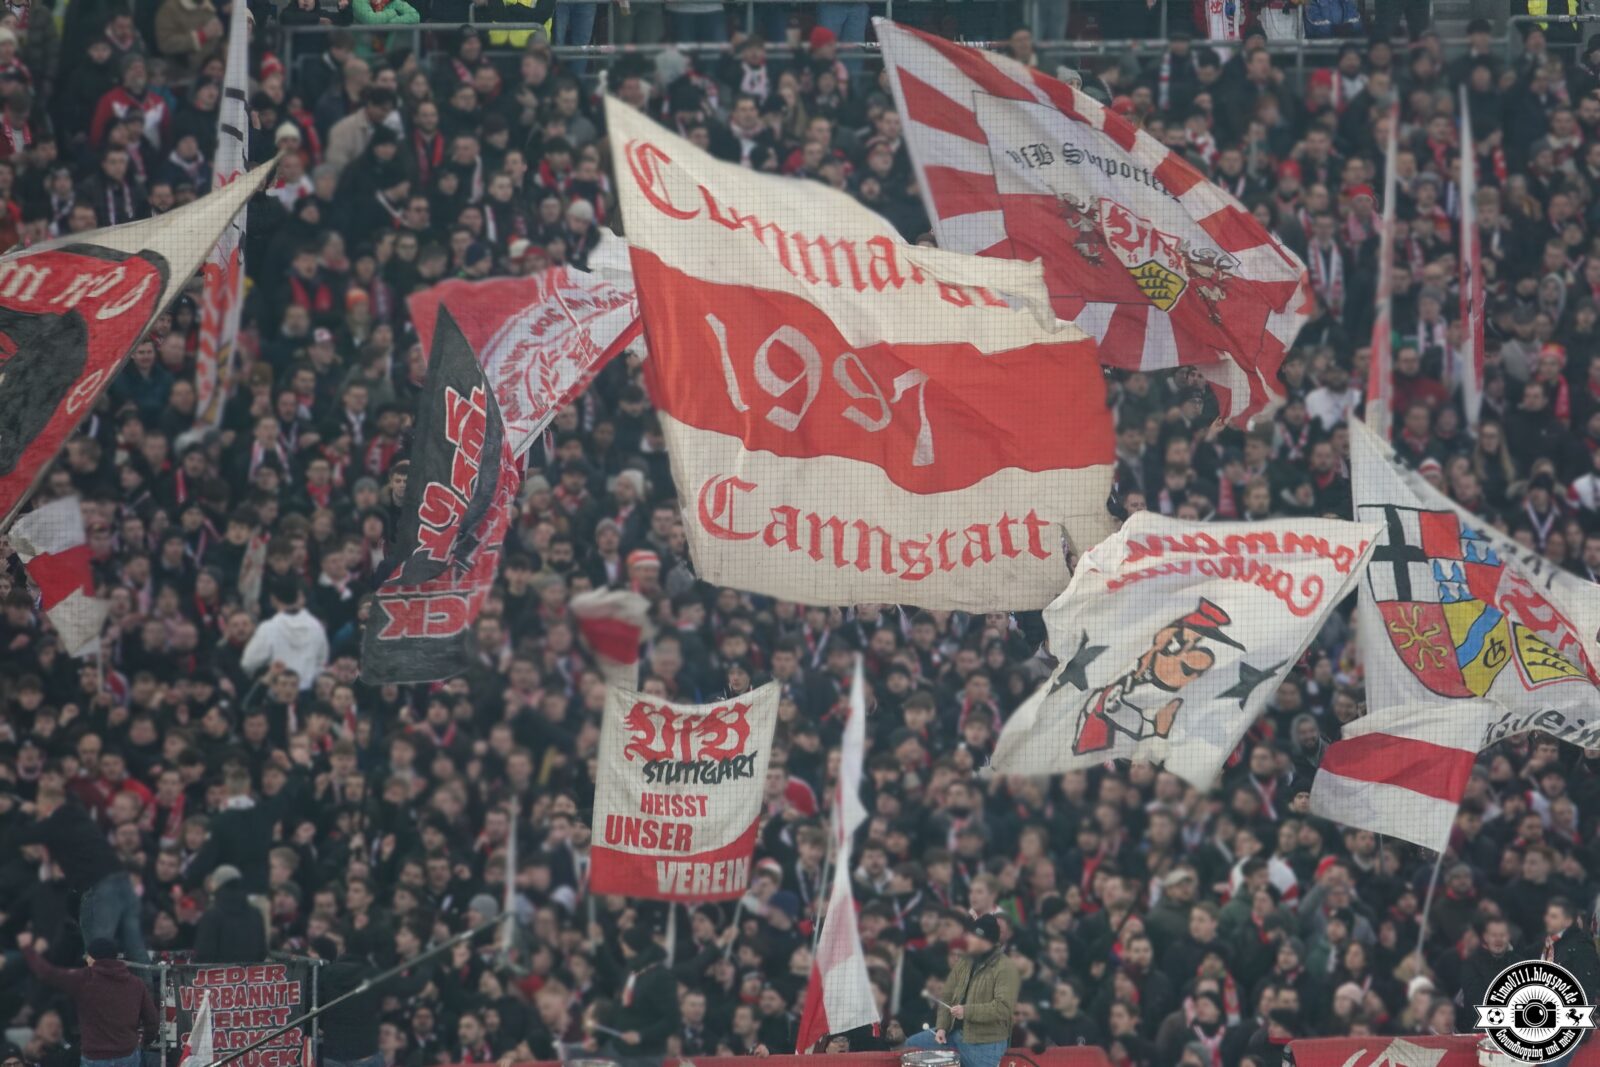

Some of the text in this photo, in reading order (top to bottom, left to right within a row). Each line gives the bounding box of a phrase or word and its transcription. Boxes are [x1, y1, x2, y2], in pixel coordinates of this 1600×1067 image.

[704, 312, 935, 467] 1997
[697, 473, 1053, 581] Cannstatt
[623, 701, 753, 766] VfB
[642, 750, 758, 785] STUTTGART
[640, 791, 709, 818] HEISST
[604, 814, 694, 852] UNSER
[655, 855, 750, 896] VEREIN
[192, 963, 288, 988] JEDER
[179, 980, 301, 1011] VERBANNTE
